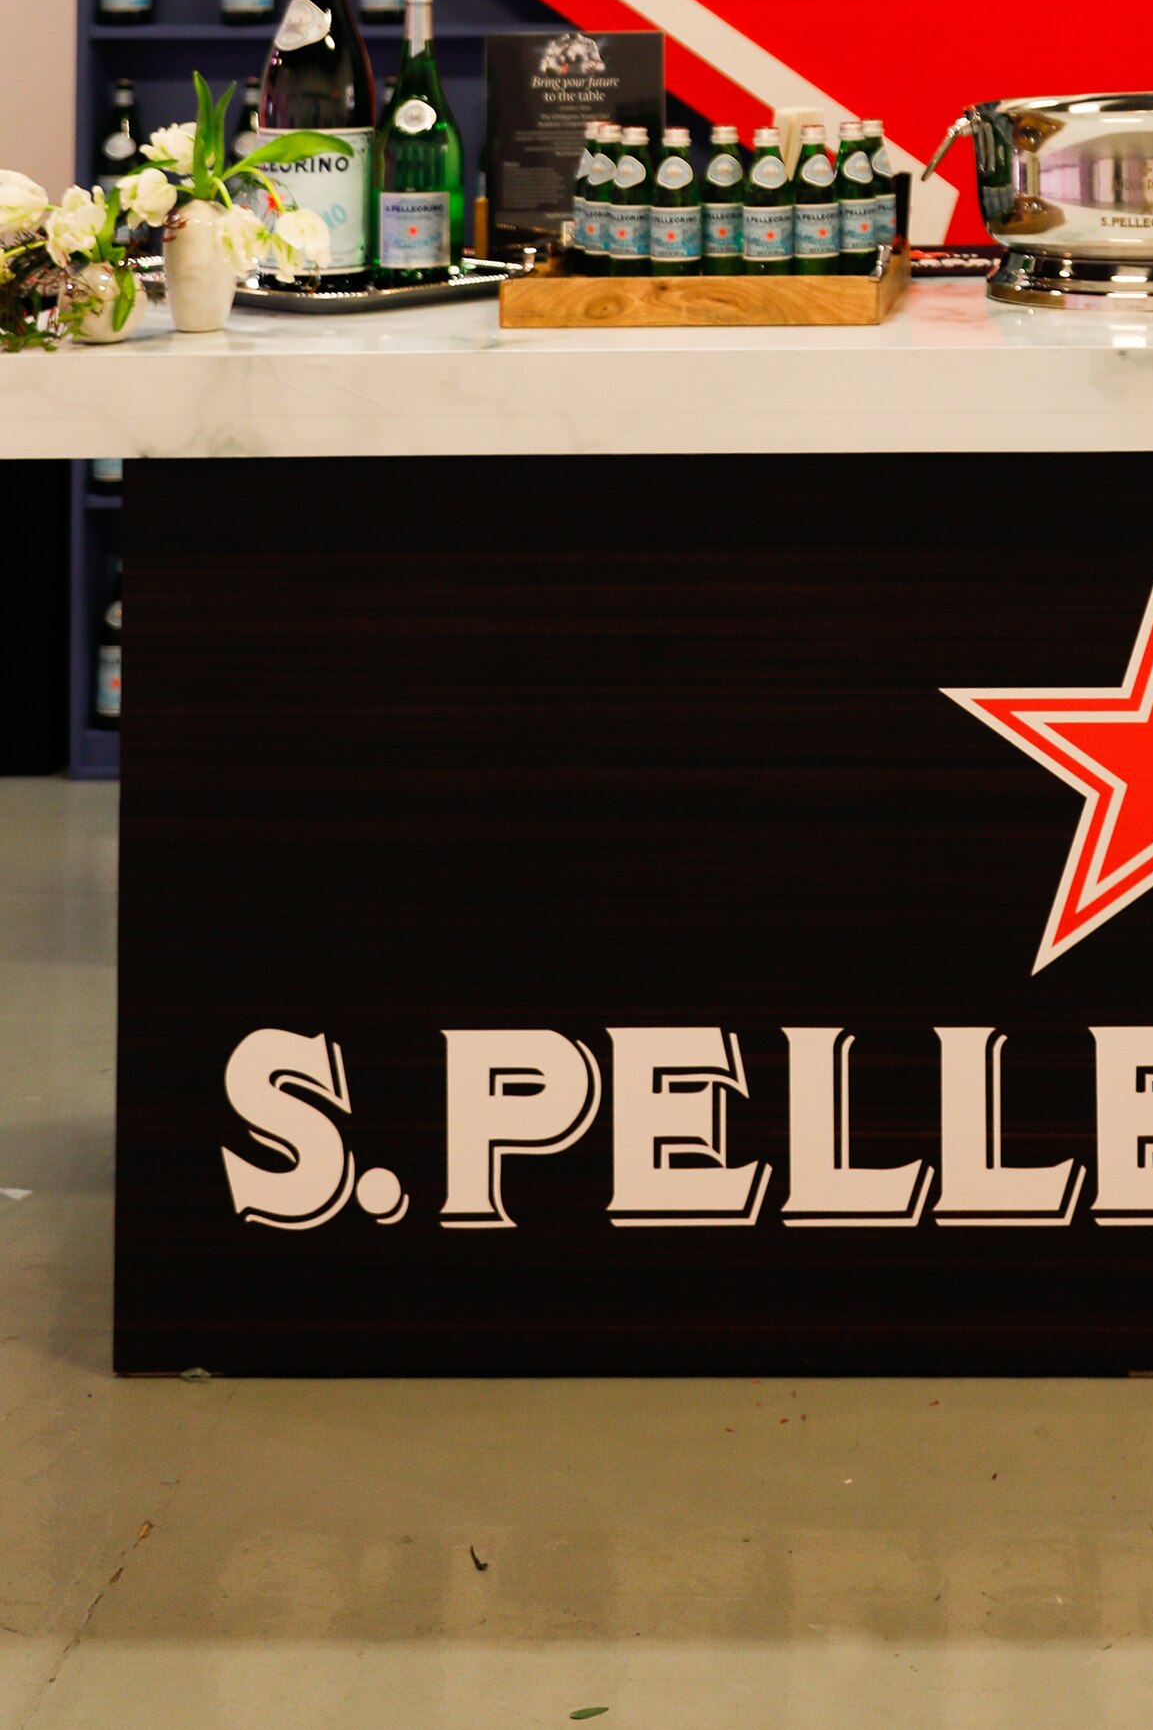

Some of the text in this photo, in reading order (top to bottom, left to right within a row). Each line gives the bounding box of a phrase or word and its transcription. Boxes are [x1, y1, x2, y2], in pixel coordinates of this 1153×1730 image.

[531, 76, 561, 90] Bring
[562, 78, 585, 90] your
[544, 90, 606, 102] to the table
